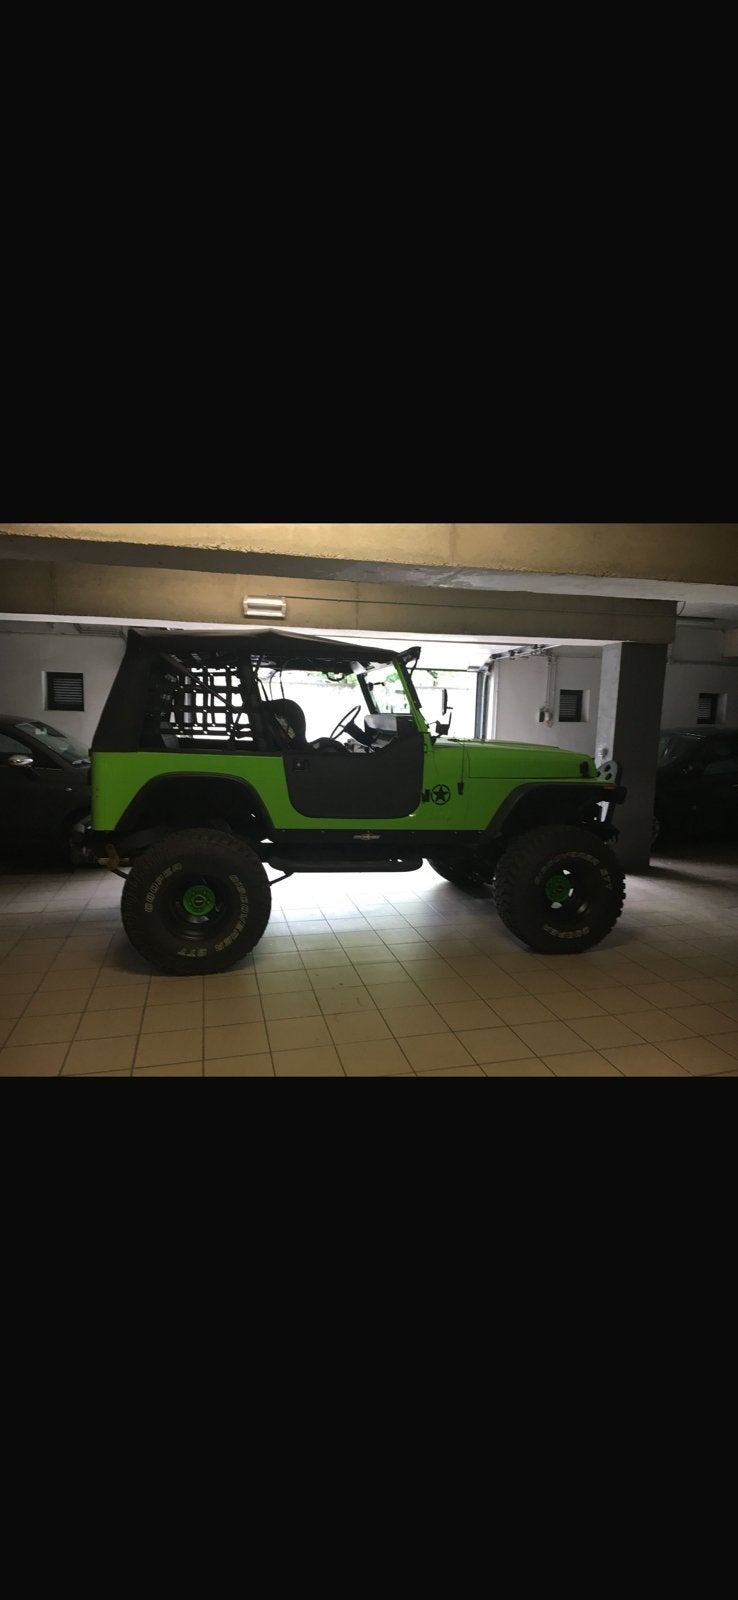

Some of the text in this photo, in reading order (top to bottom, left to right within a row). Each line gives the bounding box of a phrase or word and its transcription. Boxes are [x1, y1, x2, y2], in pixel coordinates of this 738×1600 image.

[144, 862, 183, 913] COOPER
[177, 874, 249, 958] DISCOVERER STT
